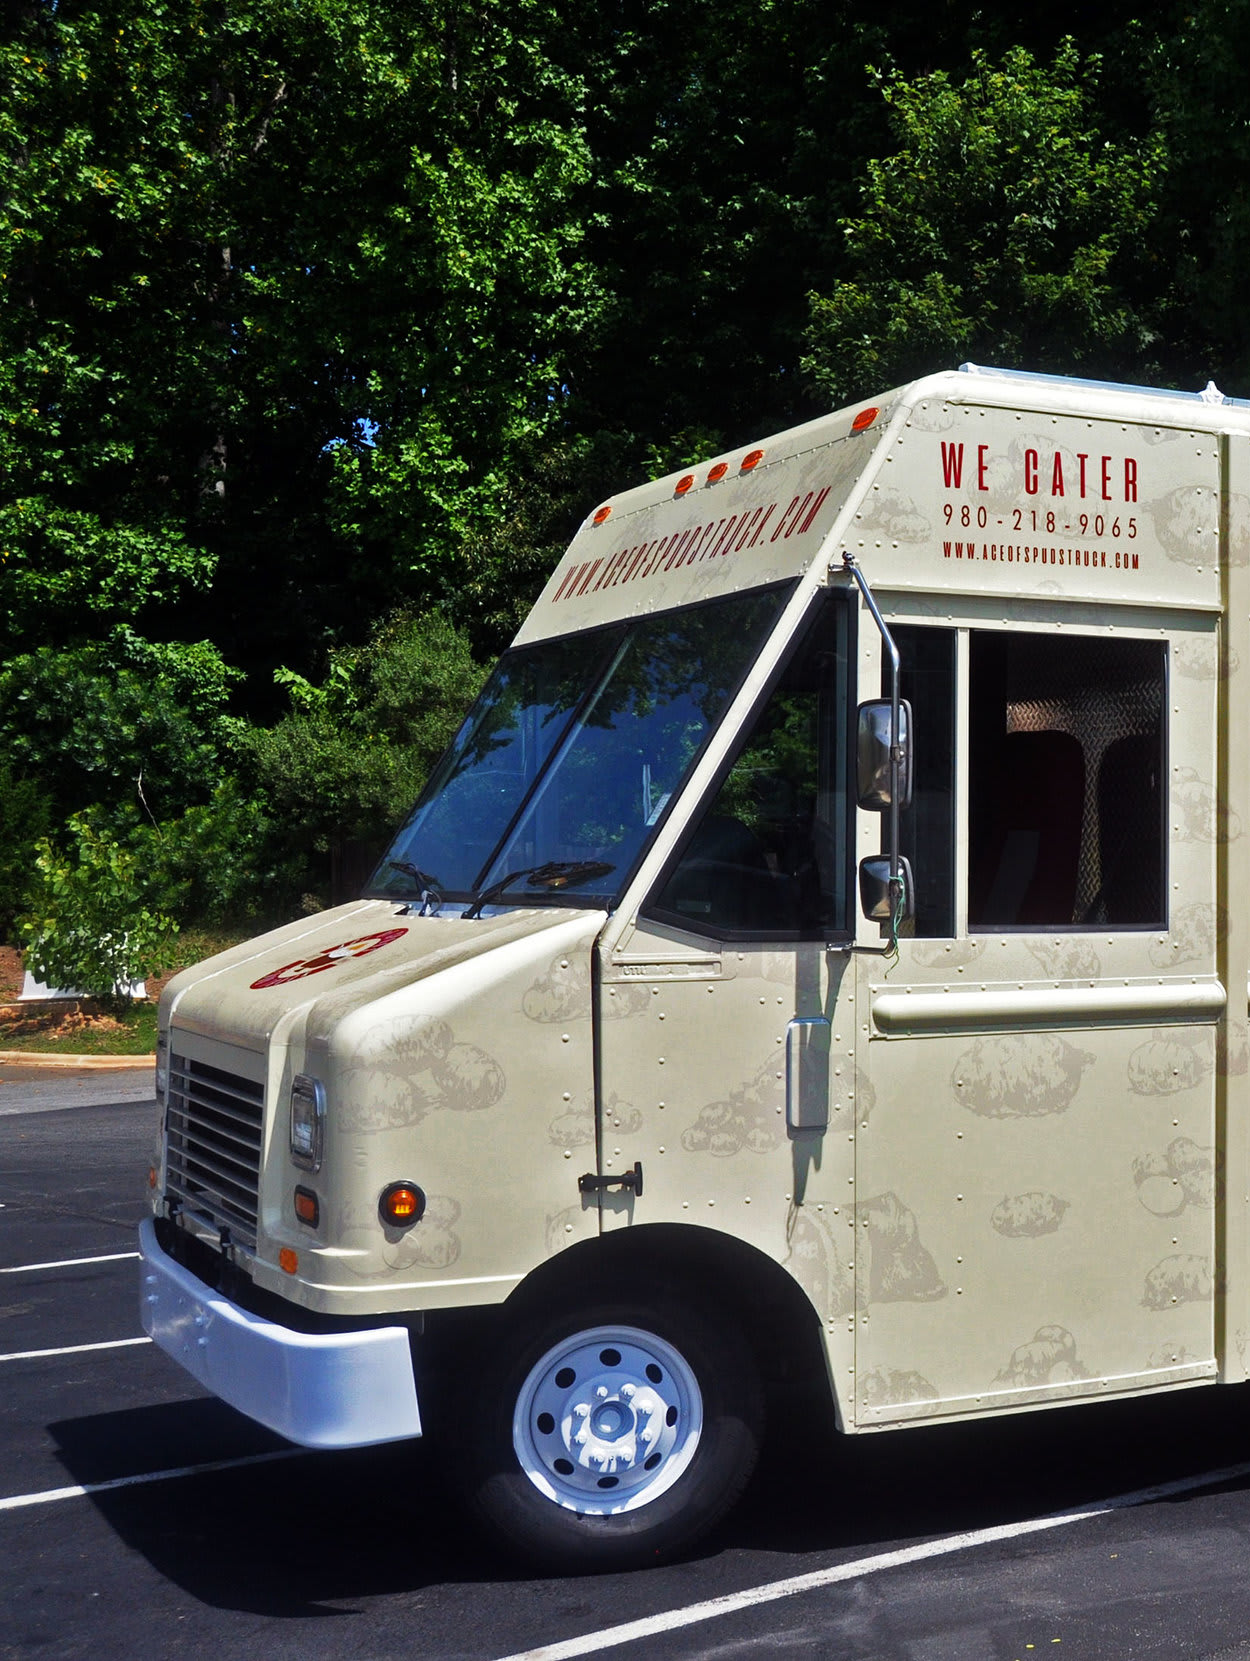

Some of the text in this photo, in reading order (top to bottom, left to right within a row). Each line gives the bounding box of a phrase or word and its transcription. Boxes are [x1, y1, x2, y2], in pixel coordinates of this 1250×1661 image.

[940, 441, 1137, 502] WE CATER
[552, 485, 832, 603] WWW.ACEOFSPUDSTRUCK.COM
[943, 503, 1137, 539] 980-218-9065
[943, 541, 1139, 570] WWW.ACEOFSPUDSTRUCK.COM
